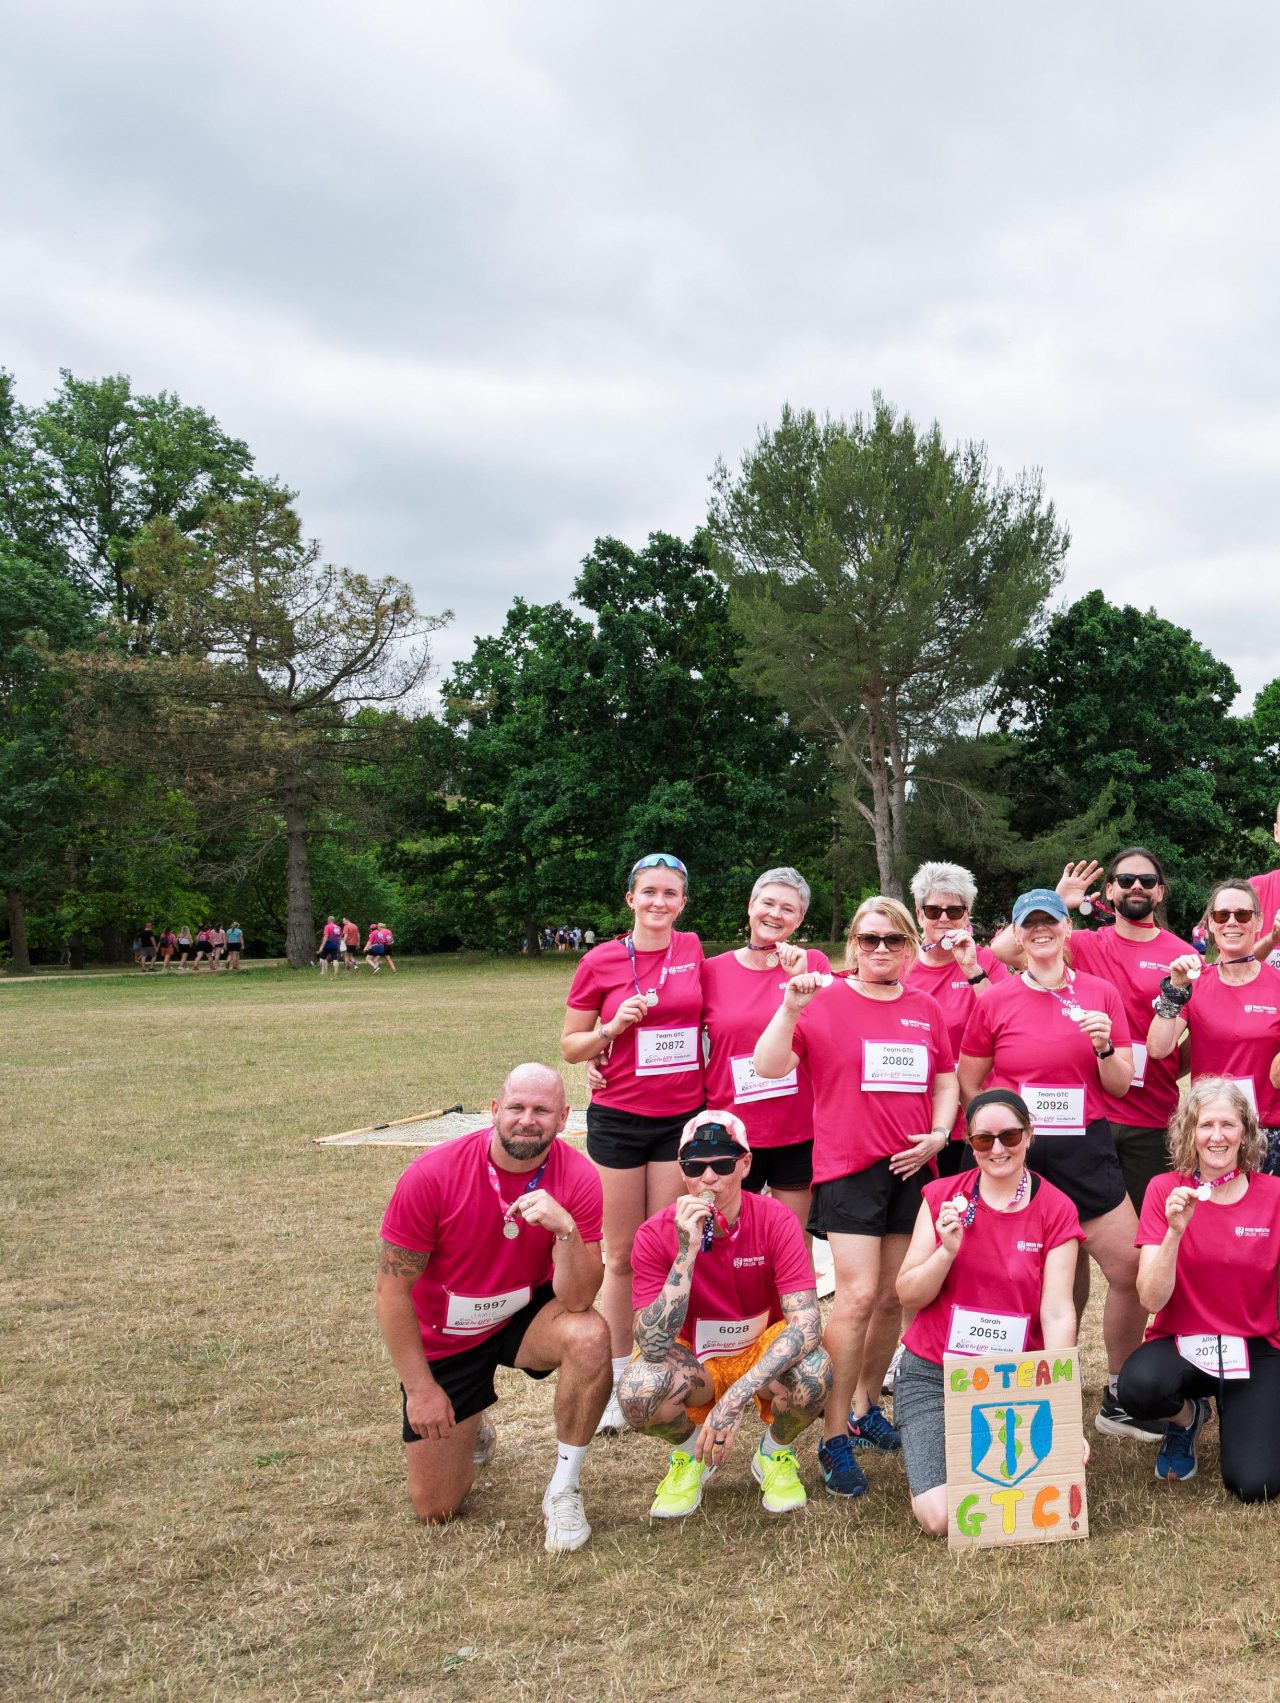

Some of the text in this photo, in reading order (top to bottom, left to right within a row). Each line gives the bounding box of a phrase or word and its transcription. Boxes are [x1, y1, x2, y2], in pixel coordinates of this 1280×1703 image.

[655, 1040, 685, 1051] 20872
[882, 1055, 915, 1066] 20802
[1036, 1100, 1069, 1110] 20926
[474, 1299, 507, 1312] 5997
[980, 1317, 1001, 1325] Sarah
[719, 1324, 750, 1334] 6028
[969, 1326, 1008, 1340] 20653
[1195, 1344, 1228, 1356] 20702
[950, 1358, 1073, 1393] GO TEAM
[956, 1484, 1082, 1537] GTC!
